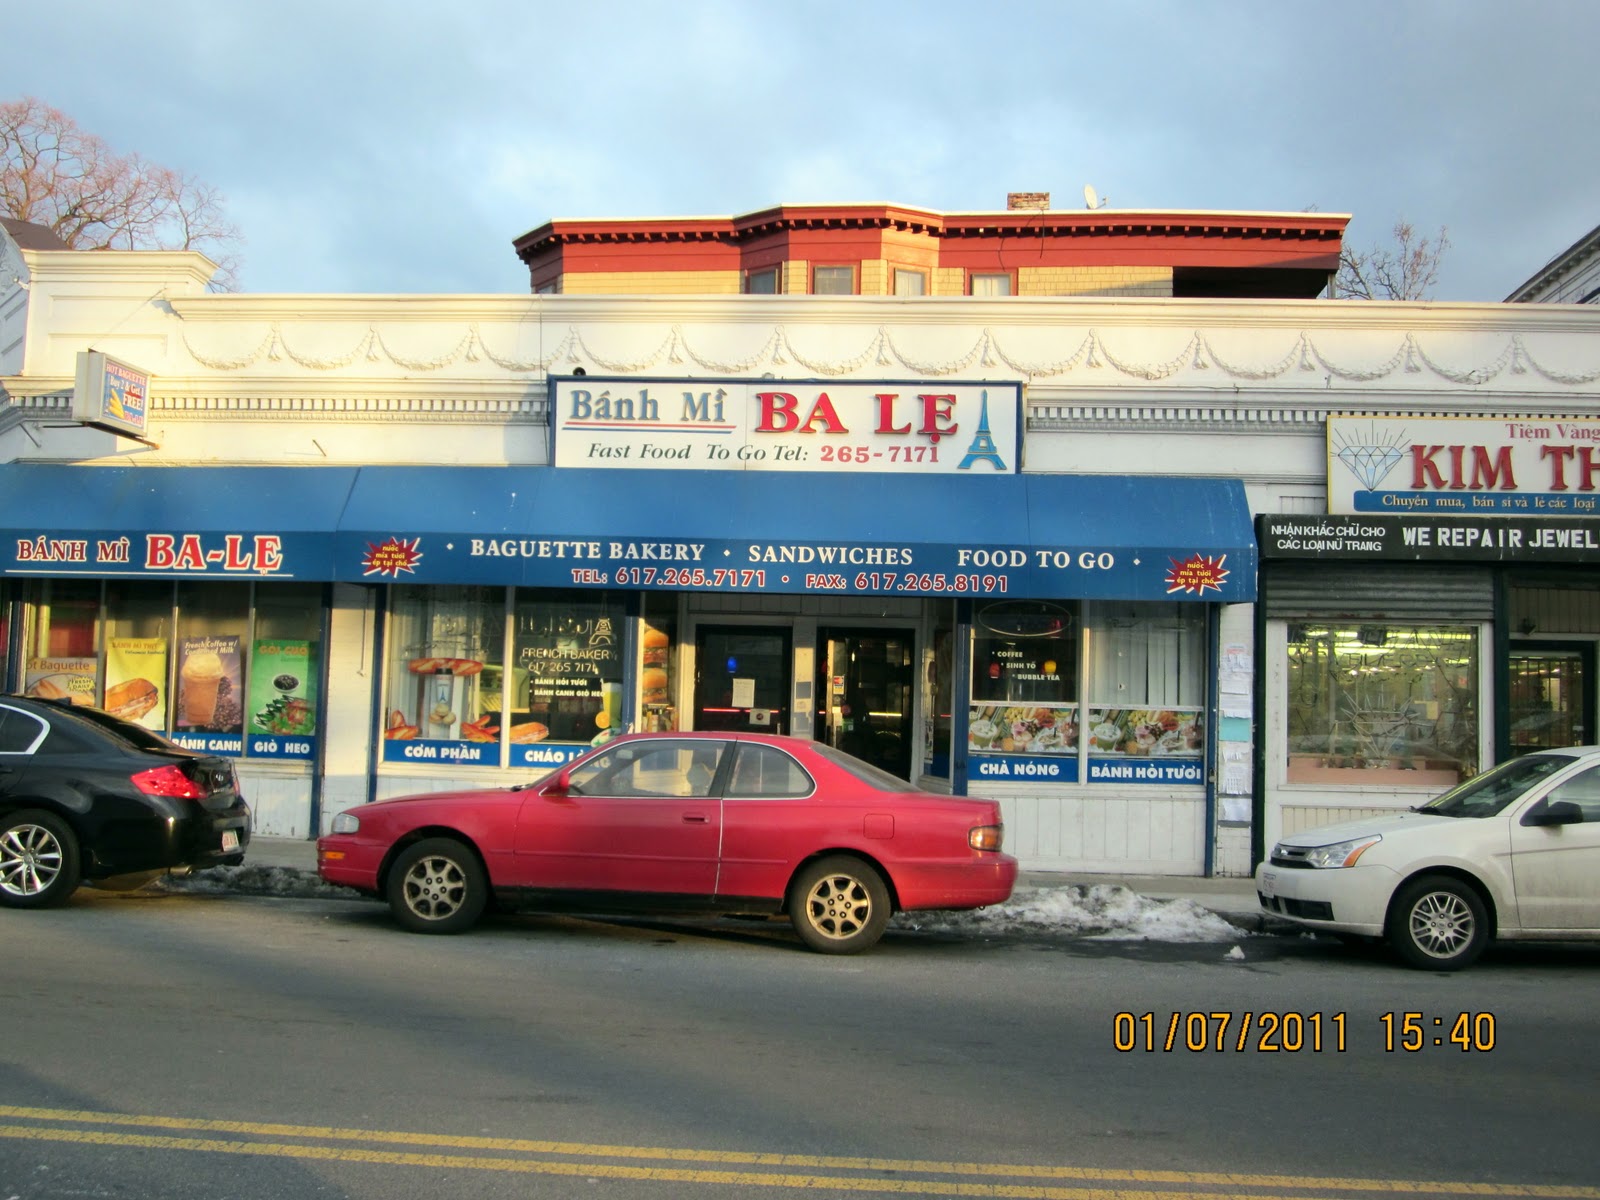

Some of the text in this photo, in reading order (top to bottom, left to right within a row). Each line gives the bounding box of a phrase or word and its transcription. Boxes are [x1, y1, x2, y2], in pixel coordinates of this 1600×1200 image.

[570, 389, 660, 421] Bánh
[755, 392, 849, 433] BA
[1505, 423, 1550, 443] Tiệm
[587, 443, 939, 463] Fast Food To Go Tel: 265-7171
[1410, 444, 1518, 490] KIM
[1382, 494, 1428, 510] Chuyên
[1436, 498, 1465, 509] mua,
[1473, 496, 1494, 508] bán
[1515, 496, 1528, 508] và
[1548, 497, 1567, 508] các
[1361, 527, 1385, 537] CHO
[1402, 527, 1600, 549] WE REPAIR JEWEL
[17, 536, 87, 562] BÁNH
[97, 537, 130, 562] MÌ
[1277, 536, 1300, 549] CÁC
[1345, 540, 1382, 551] TRANG
[471, 539, 1115, 570] BAGUETTE BAKERY SANDWICHES FOOD TO GO
[571, 567, 1009, 593] TEL: 617.265.7171 FAX: 617.265.8191
[206, 640, 228, 648] Coffee
[522, 647, 615, 660] FRENCH BAKERY
[41, 660, 90, 672] Baguette
[528, 662, 546, 671] 617
[550, 663, 571, 672] 265
[208, 739, 241, 752] CANH
[285, 742, 310, 754] HEO
[524, 748, 565, 763] CHÁO
[1014, 761, 1060, 776] NÓNG
[1091, 763, 1133, 778] BÁNH
